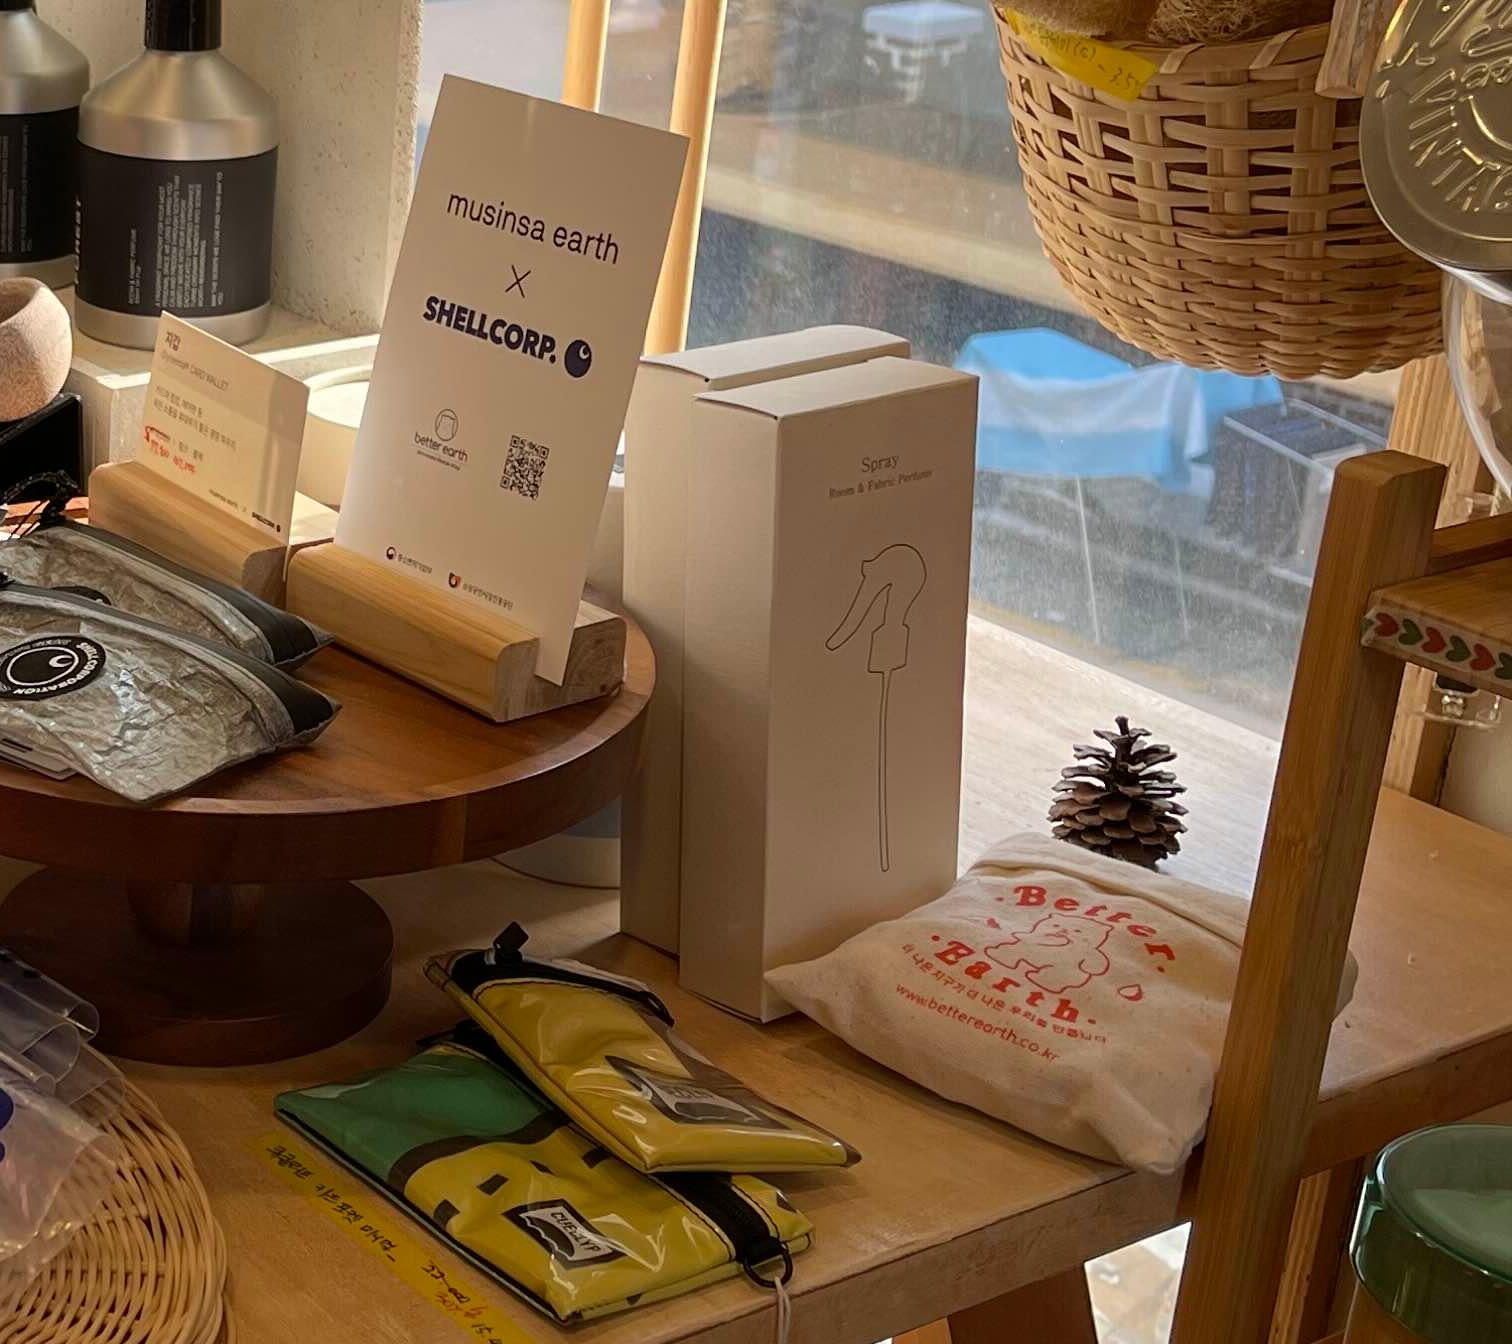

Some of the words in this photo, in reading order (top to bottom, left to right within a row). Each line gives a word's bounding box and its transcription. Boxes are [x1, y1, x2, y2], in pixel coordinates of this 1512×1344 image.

[446, 193, 546, 243] musinsa
[552, 226, 620, 265] earth
[423, 295, 558, 364] SHELLCORP.
[414, 431, 442, 451] better
[442, 444, 469, 463] earth
[861, 455, 900, 473] Spray
[12, 658, 99, 695] CORPORATION
[1013, 885, 1177, 961] Better
[911, 952, 936, 974] 나은
[978, 994, 1006, 1012] 나은
[934, 940, 1082, 1025] Earth
[895, 982, 1061, 1062] www.betterearth.co.kr
